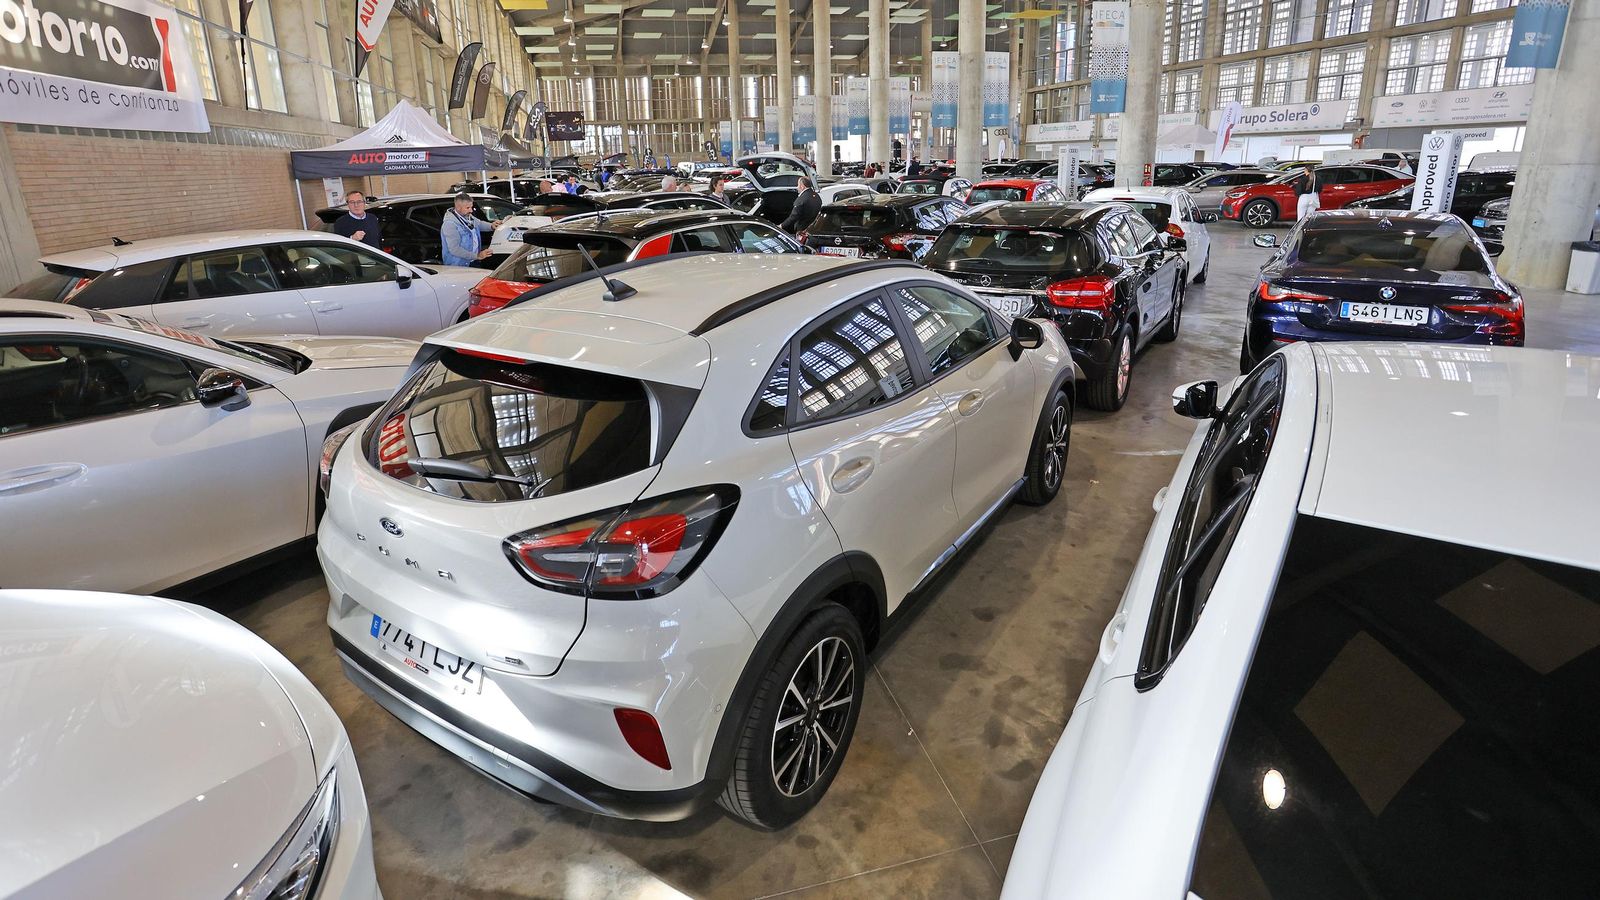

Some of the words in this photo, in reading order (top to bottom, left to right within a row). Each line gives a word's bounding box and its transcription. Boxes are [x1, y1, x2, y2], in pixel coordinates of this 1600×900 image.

[1095, 10, 1125, 20] IFECA
[934, 56, 957, 65] IFECA
[986, 57, 1007, 65] IFECA
[78, 84, 101, 105] de
[109, 92, 180, 113] confianza
[1237, 108, 1267, 126] rupo
[1269, 107, 1309, 123] Solera
[348, 152, 387, 165] AUTO
[1069, 156, 1077, 176] Motor
[1447, 153, 1458, 188] Motor
[1418, 154, 1439, 212] Approved
[1351, 304, 1388, 319] 5461
[1394, 308, 1423, 321] LNS
[403, 657, 418, 670] AUTO
